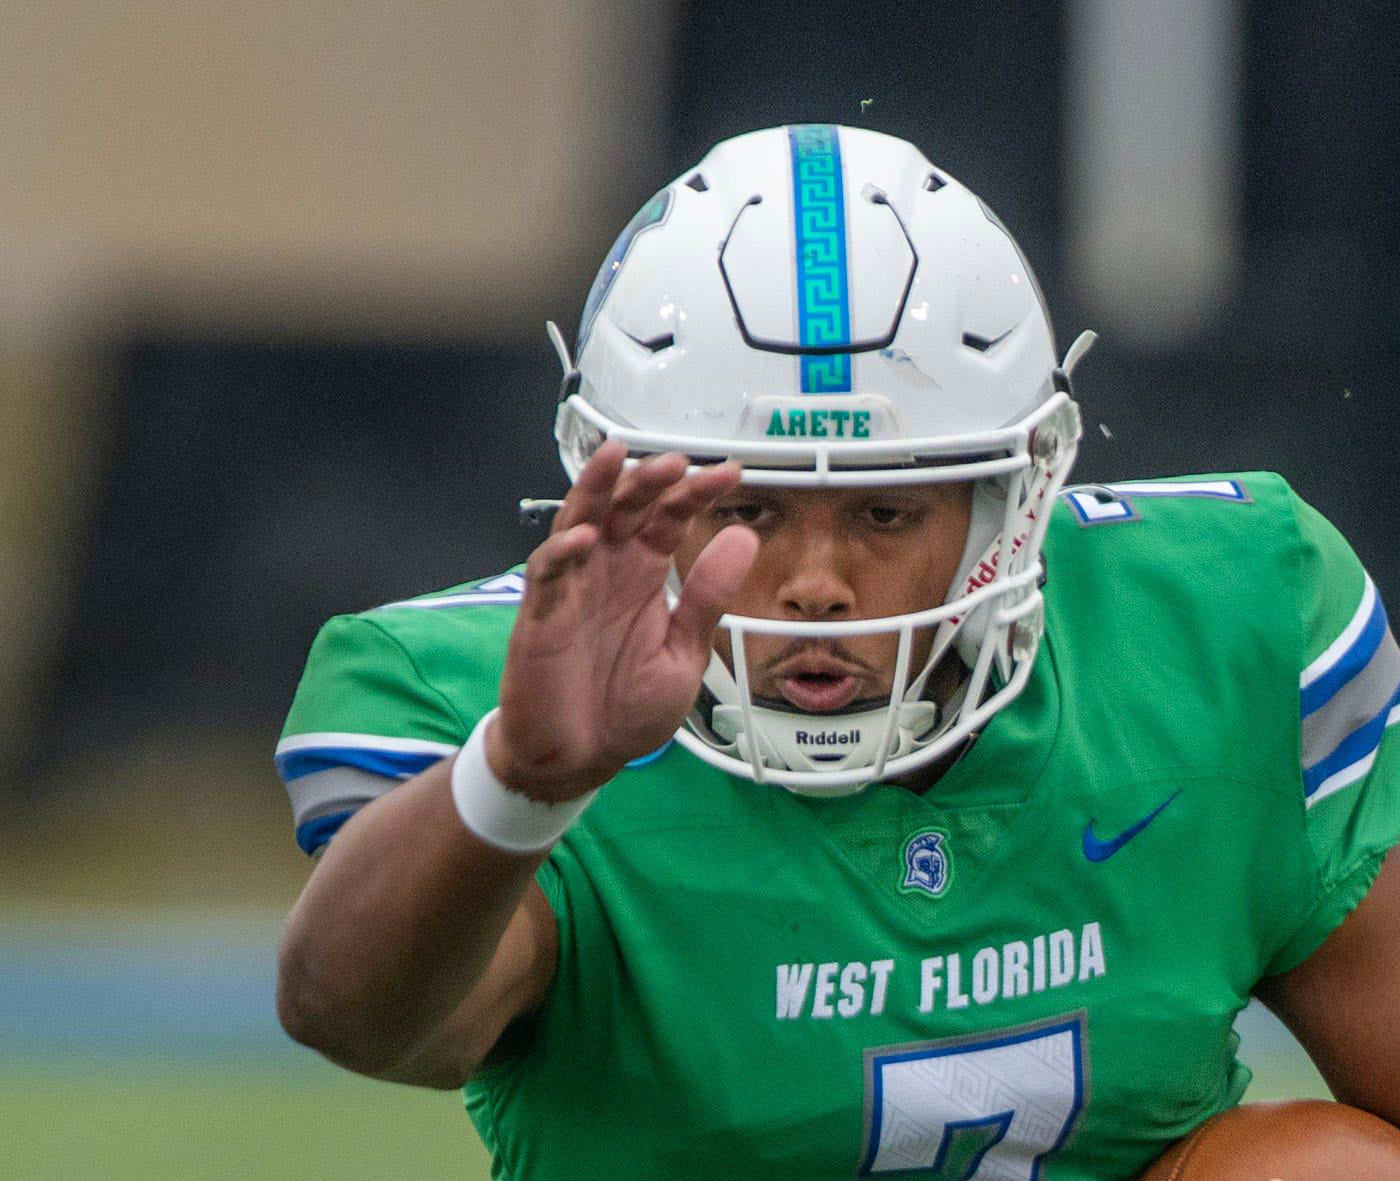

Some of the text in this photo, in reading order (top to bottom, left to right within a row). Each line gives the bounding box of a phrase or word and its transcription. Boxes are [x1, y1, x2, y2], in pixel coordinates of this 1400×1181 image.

[765, 407, 871, 438] ARETE
[795, 729, 861, 745] Riddell
[775, 920, 1106, 1019] WEST FLORIDA
